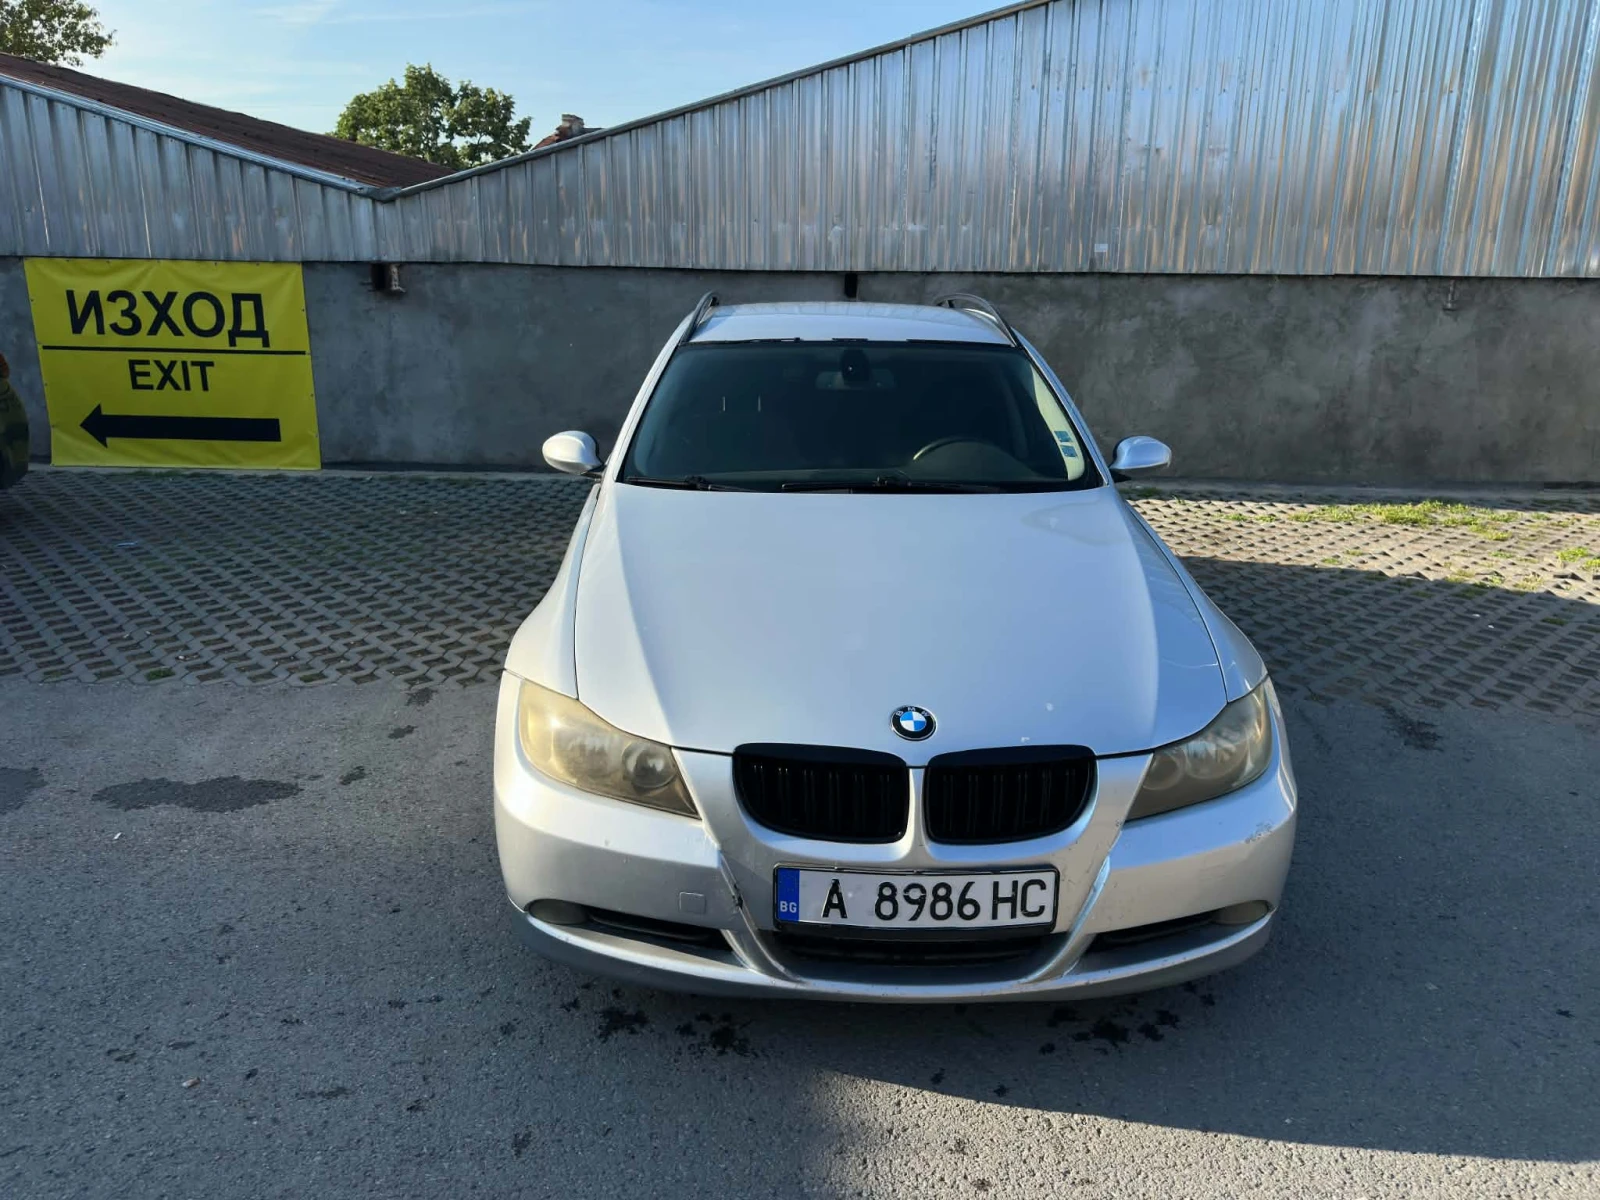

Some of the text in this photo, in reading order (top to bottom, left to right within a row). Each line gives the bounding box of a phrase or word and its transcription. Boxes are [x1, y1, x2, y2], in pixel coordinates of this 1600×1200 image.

[65, 289, 271, 348] ИЗХОД
[128, 359, 215, 392] EXIT
[779, 901, 797, 913] BG
[874, 881, 981, 922] 8986
